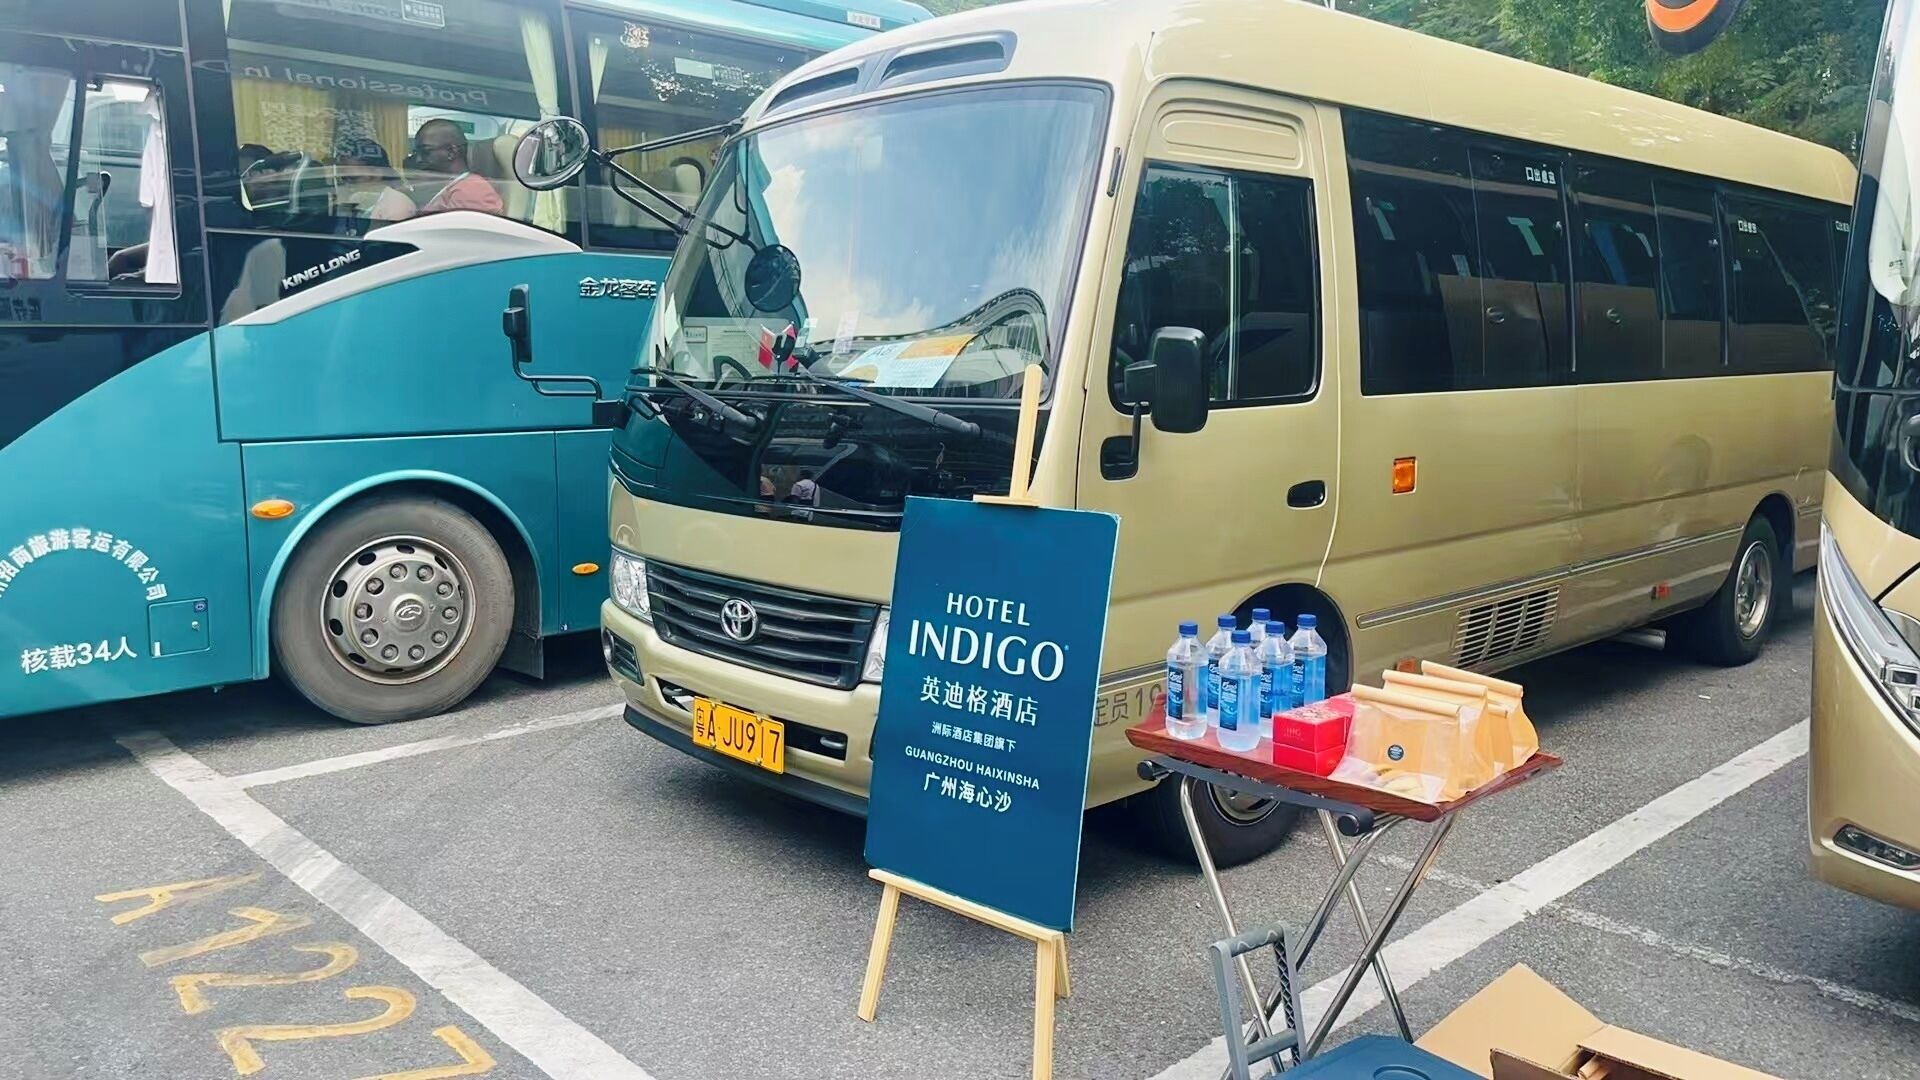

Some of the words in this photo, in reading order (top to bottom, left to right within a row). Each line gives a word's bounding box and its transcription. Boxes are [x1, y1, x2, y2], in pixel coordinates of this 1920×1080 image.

[282, 266, 320, 290] KING
[319, 248, 361, 274] LONG
[579, 276, 657, 298] 金龙客车
[946, 592, 1030, 627] HOTEL
[21, 636, 138, 675] 核载34人
[908, 619, 1065, 682] INDIGO
[920, 675, 1039, 727] 英迪格酒店
[931, 721, 1017, 753] 洲际酒店集团旗下
[905, 745, 974, 772] GUANGZHOU
[976, 764, 1040, 790] HAIXINSHA
[924, 771, 1012, 813] 广州海心沙
